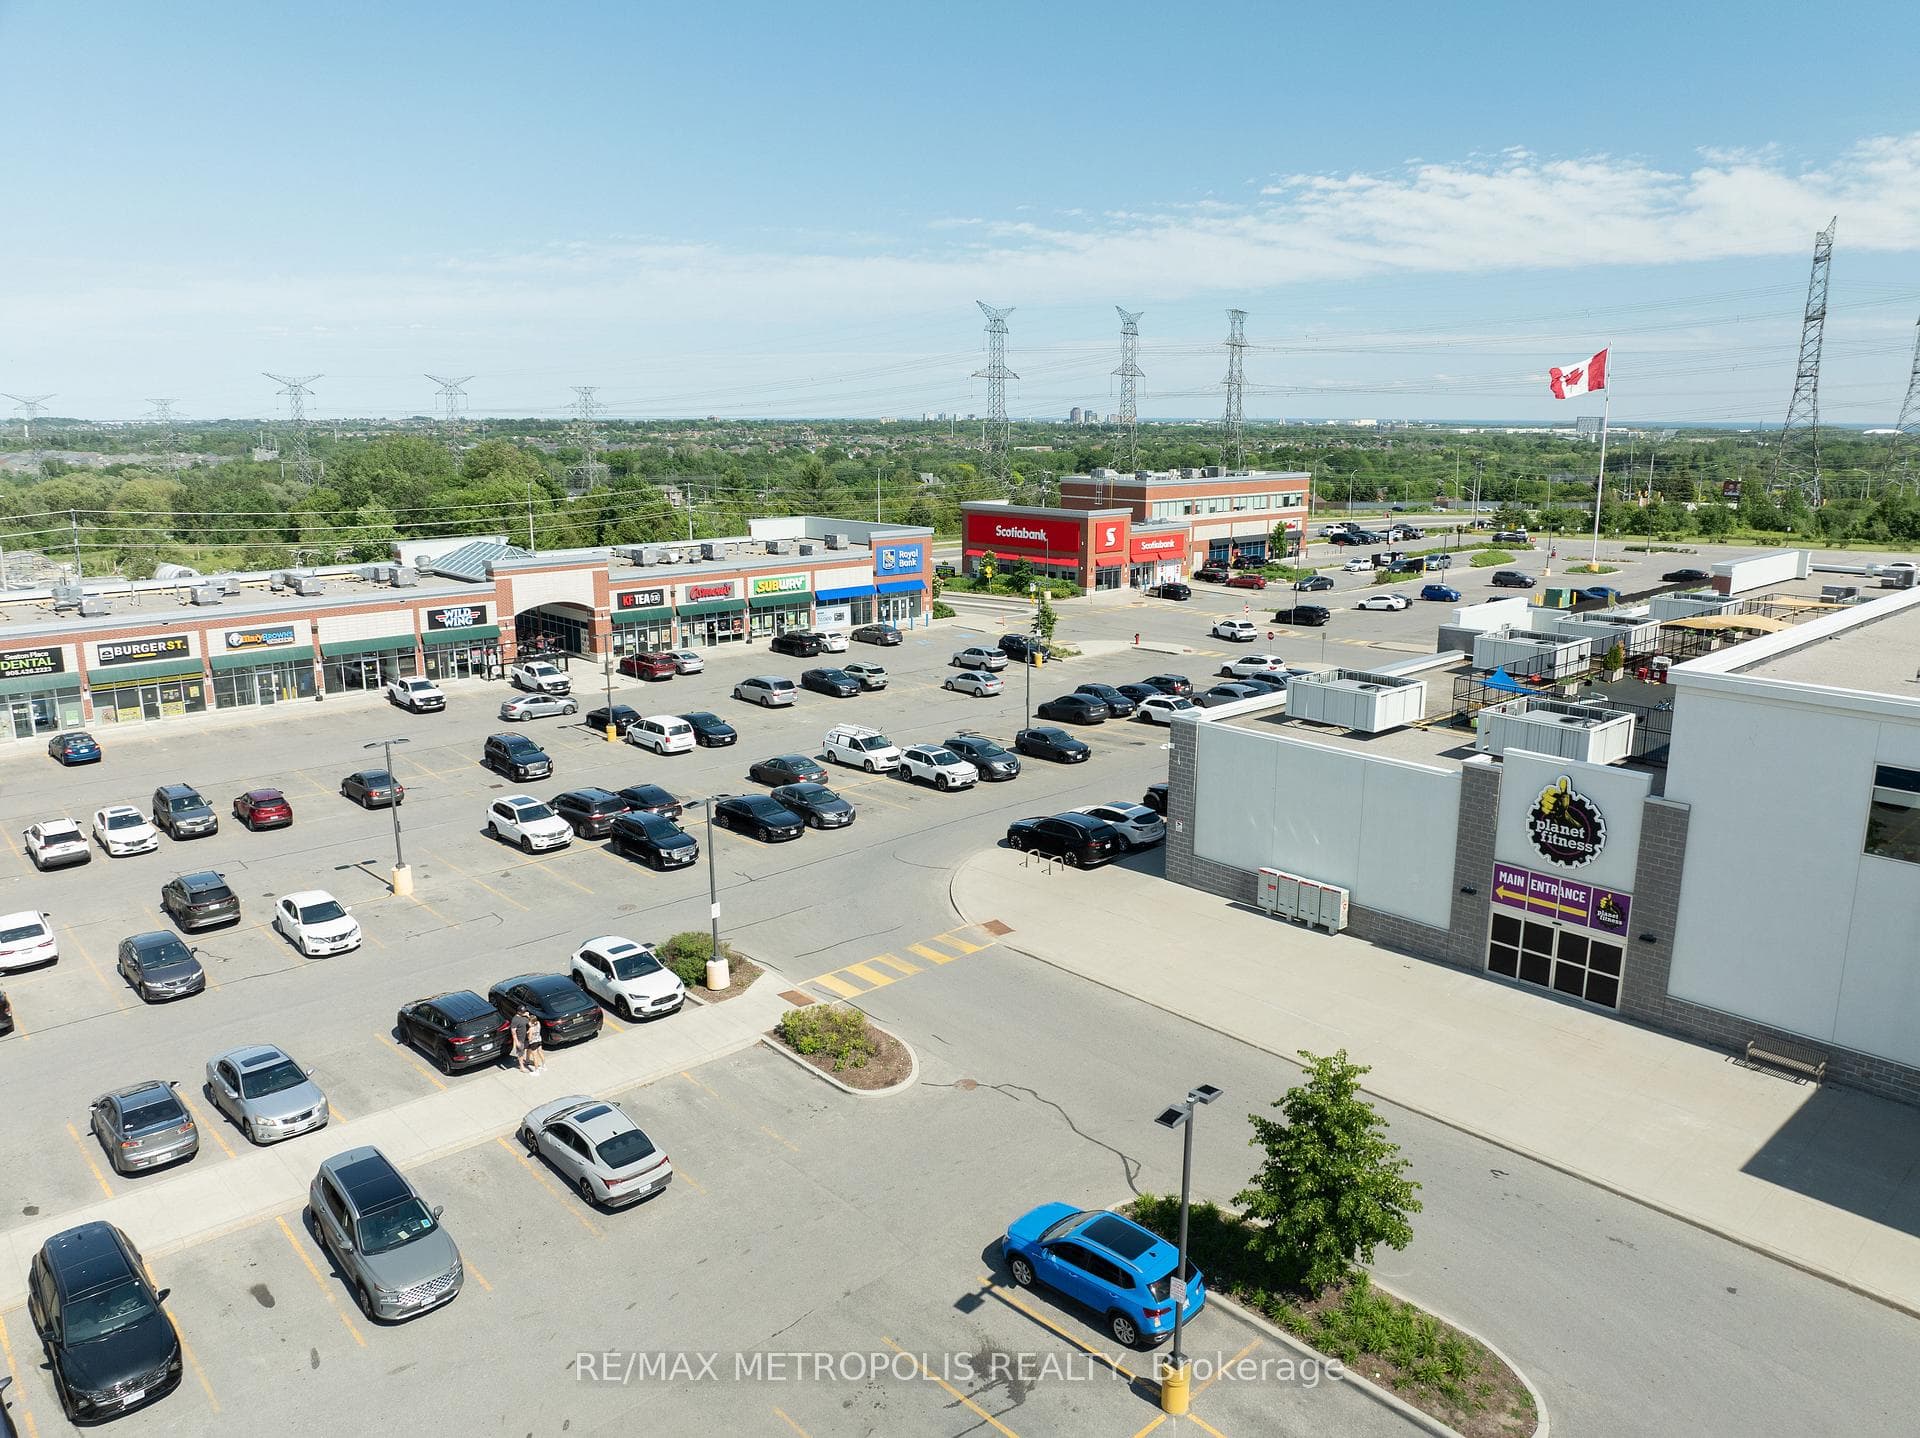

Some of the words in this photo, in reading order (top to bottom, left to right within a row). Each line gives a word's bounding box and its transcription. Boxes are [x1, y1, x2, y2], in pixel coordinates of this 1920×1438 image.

[995, 525, 1046, 541] Scotiabank
[1141, 539, 1175, 550] Scotiabank
[898, 549, 918, 559] Royal
[898, 558, 917, 568] Bank
[757, 577, 804, 592] SUBWAY
[443, 608, 472, 619] WILD
[444, 616, 474, 627] WING
[0, 657, 56, 671] DENTAL
[1535, 819, 1585, 838] planet
[1540, 830, 1593, 852] fitness
[1499, 871, 1525, 888] MAIN
[1530, 879, 1587, 903] ENTRANCE
[1597, 910, 1619, 920] planet
[1599, 915, 1623, 925] fitness
